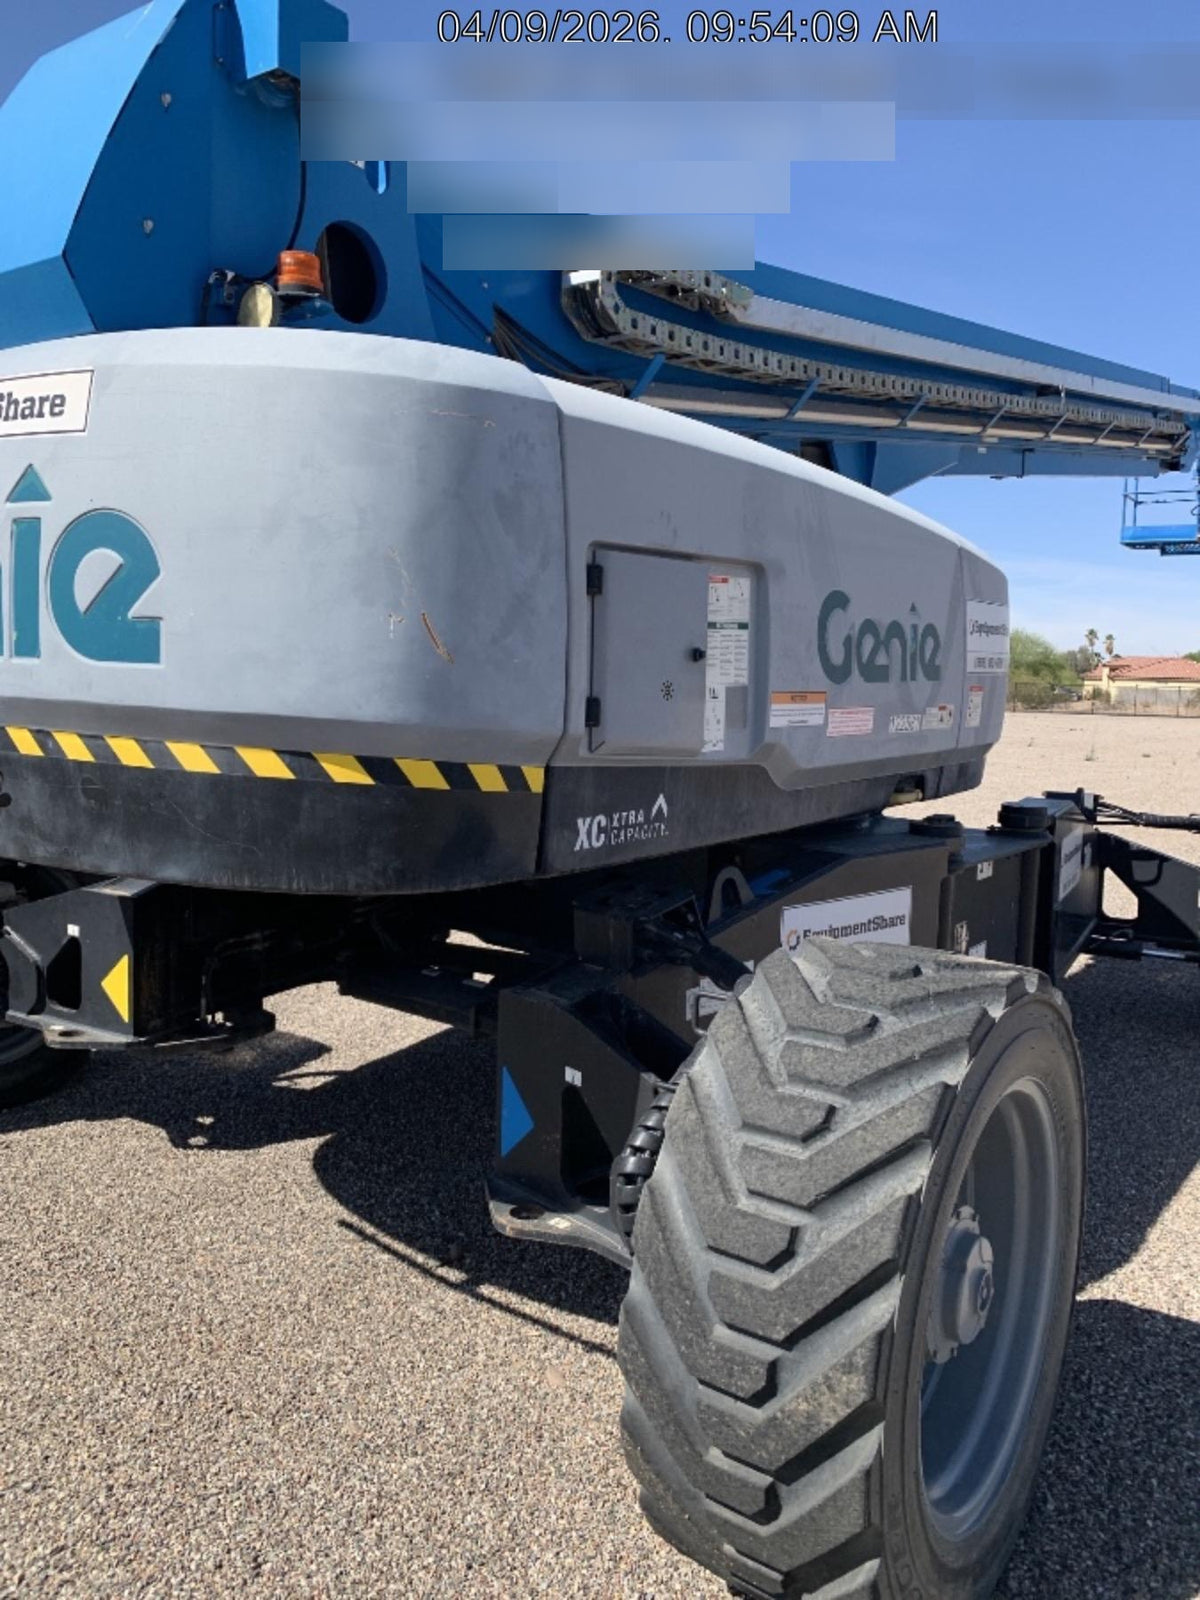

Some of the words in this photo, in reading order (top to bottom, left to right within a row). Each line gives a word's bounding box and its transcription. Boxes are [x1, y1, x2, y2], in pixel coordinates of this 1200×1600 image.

[817, 589, 941, 685] Genie
[574, 814, 607, 851] XC
[611, 809, 645, 828] XTRA
